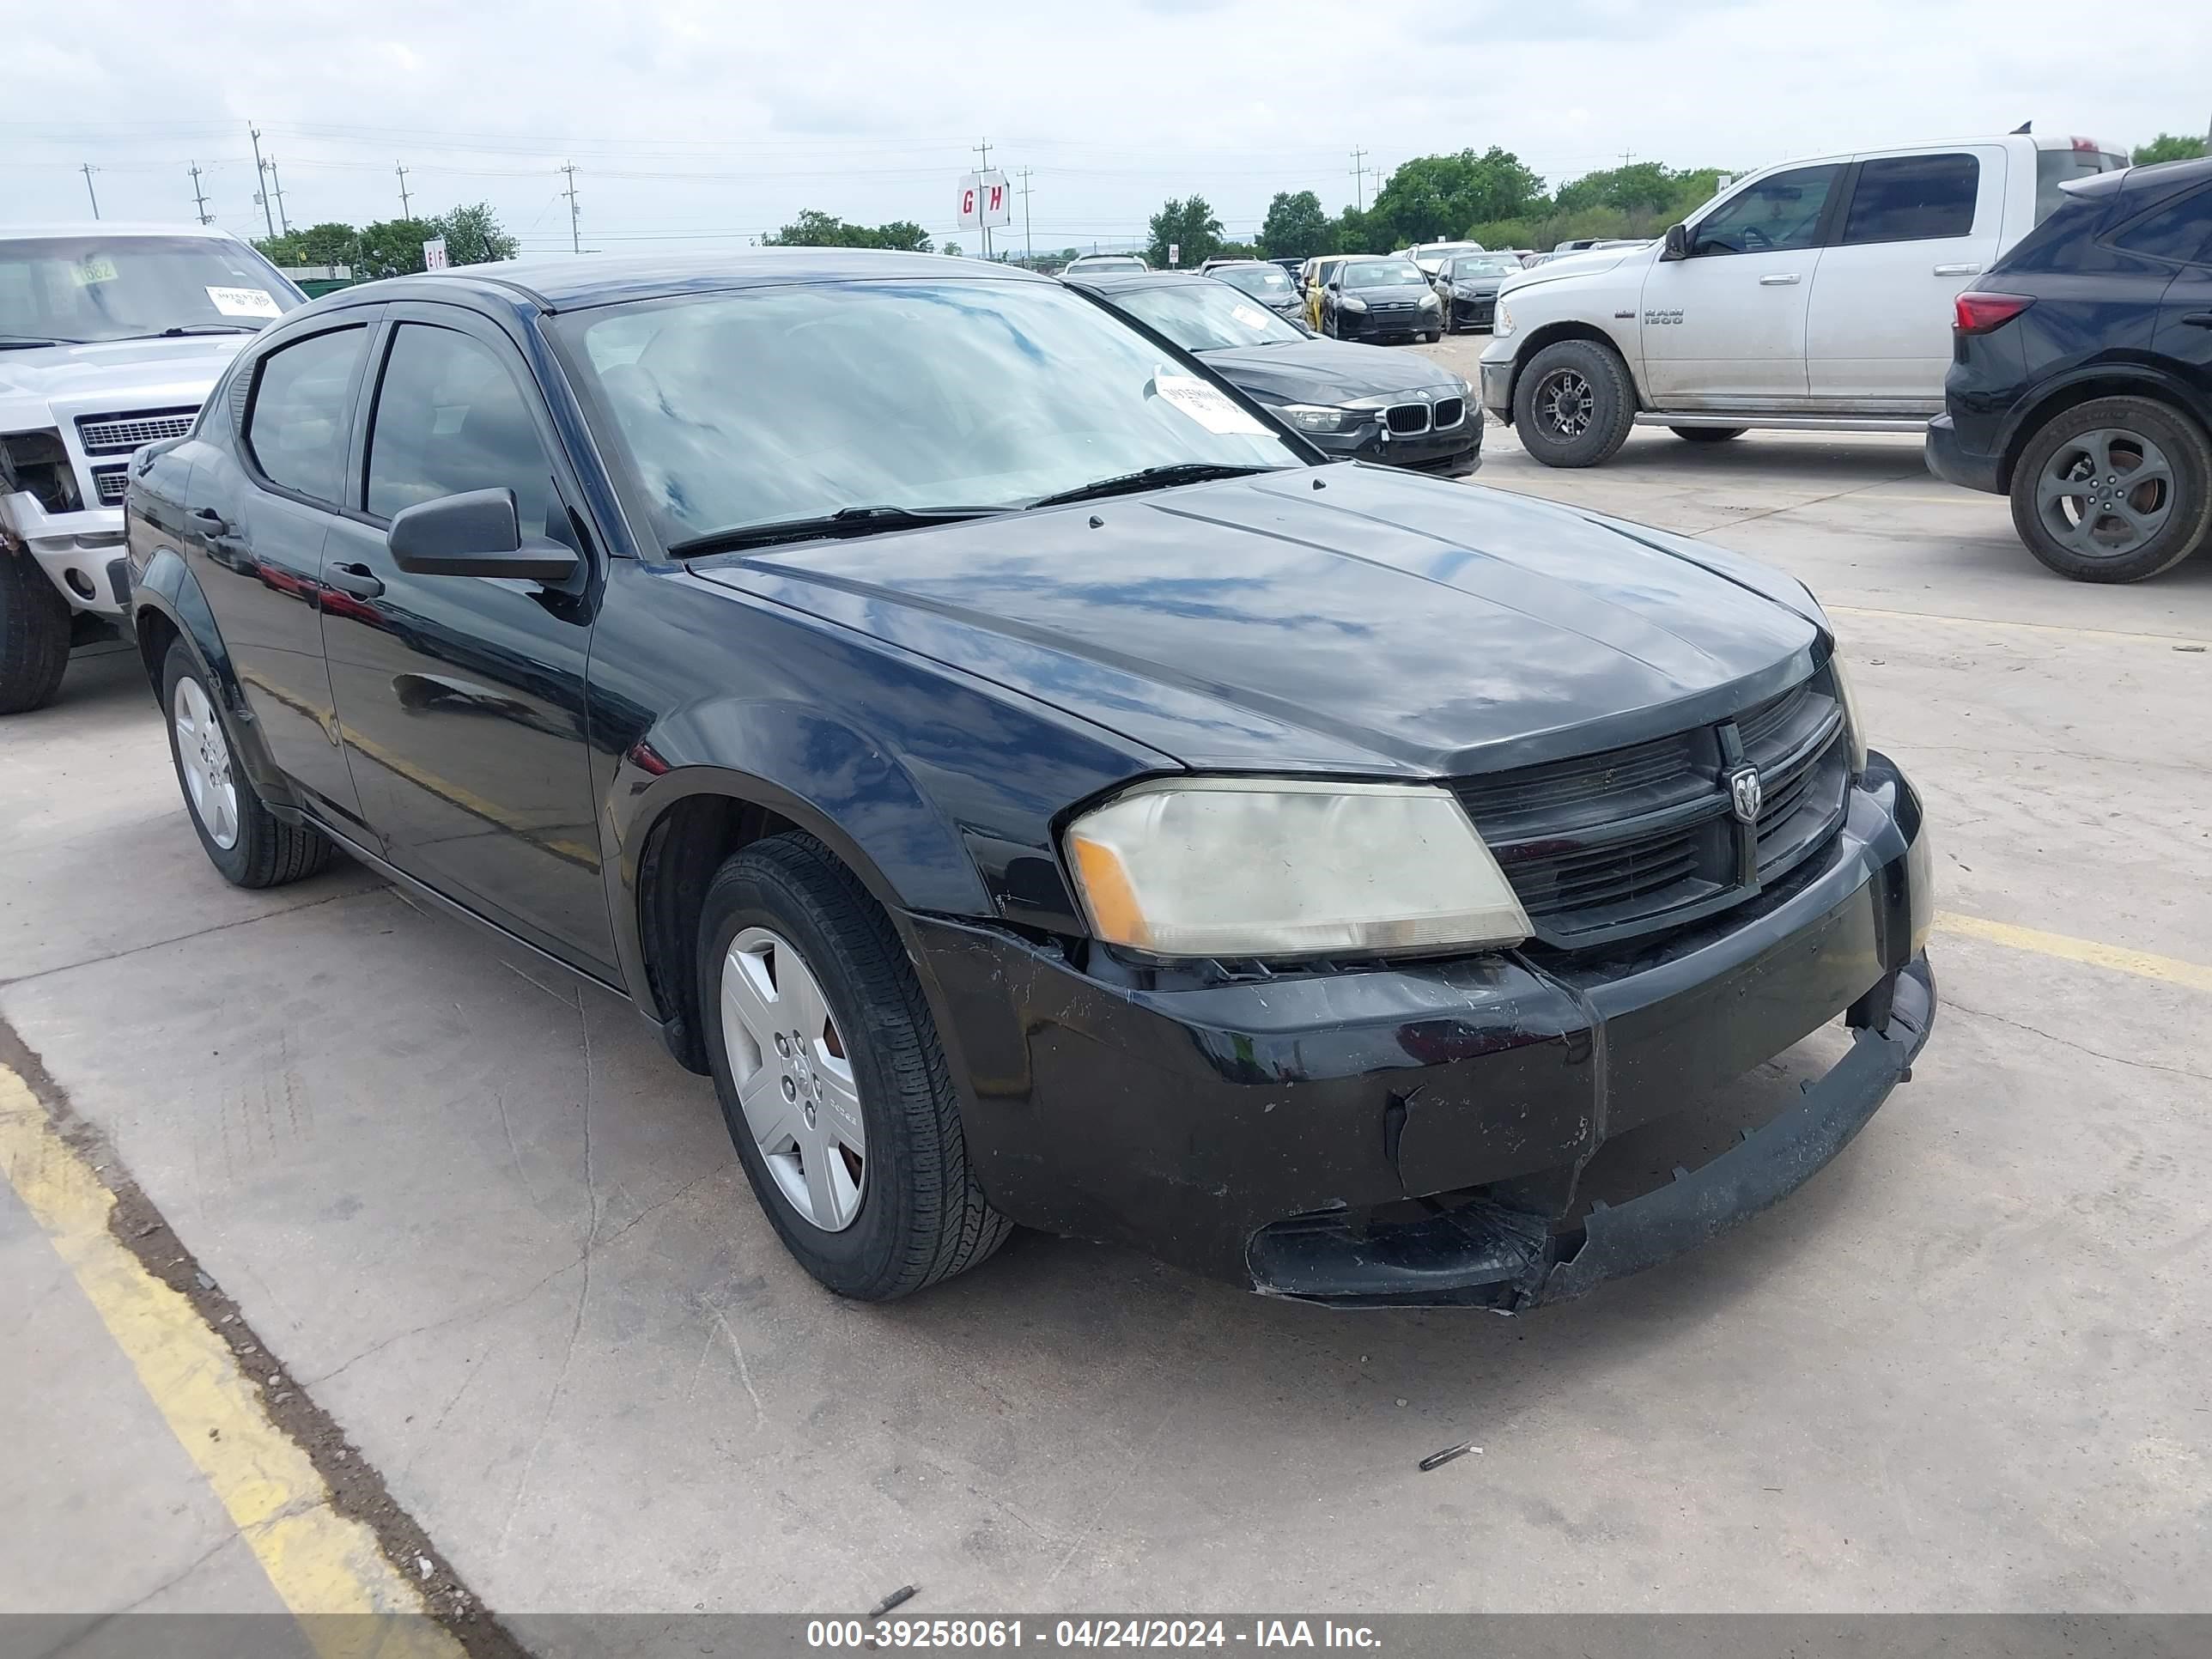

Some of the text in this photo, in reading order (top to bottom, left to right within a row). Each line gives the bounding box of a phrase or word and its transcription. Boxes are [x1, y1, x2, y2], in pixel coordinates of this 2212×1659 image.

[963, 189, 974, 215] G
[989, 185, 1002, 211] H
[428, 251, 434, 268] E
[438, 250, 443, 267] F
[1644, 308, 1684, 317] RAM
[1644, 317, 1683, 325] 1500
[830, 1098, 857, 1126] DODGE
